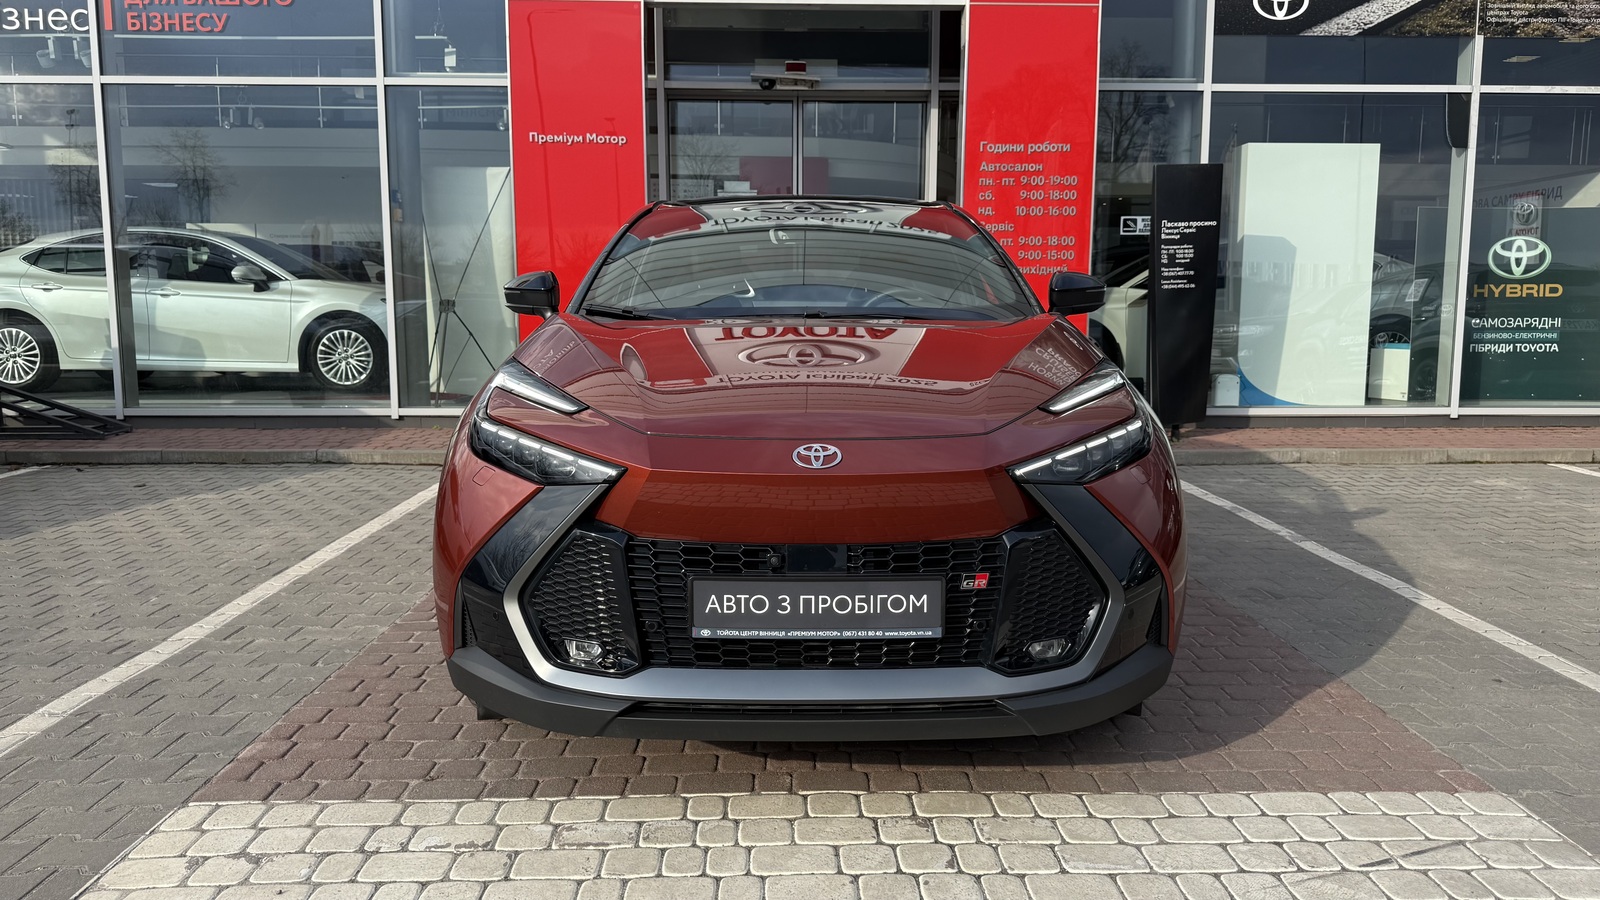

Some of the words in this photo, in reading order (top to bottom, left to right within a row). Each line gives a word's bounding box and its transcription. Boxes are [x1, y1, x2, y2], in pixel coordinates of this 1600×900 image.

[127, 12, 228, 32] БІЗНЕСУ
[529, 132, 583, 145] Преміум
[586, 133, 627, 146] Мотор
[980, 142, 1024, 154] Години
[1028, 141, 1070, 154] роботи
[980, 162, 1042, 172] Автосалон
[1021, 176, 1078, 185] 9:00-19:00
[979, 191, 995, 200] сб.
[1020, 190, 1077, 200] 9:00-18:00
[978, 206, 995, 215] нд.
[1016, 206, 1076, 216] 10:00-16:00
[1019, 236, 1075, 246] 9:00-18:00
[1018, 250, 1074, 260] 9:00-15:00
[1473, 283, 1564, 298] HYBRID
[1472, 318, 1561, 329] САМОЗАРЯДНІ
[1470, 344, 1513, 353] ГІБРИДИ
[1515, 344, 1559, 352] TOYOTA
[705, 594, 769, 614] АВТО
[778, 594, 790, 614] З
[800, 594, 928, 614] ПРОБІГОМ
